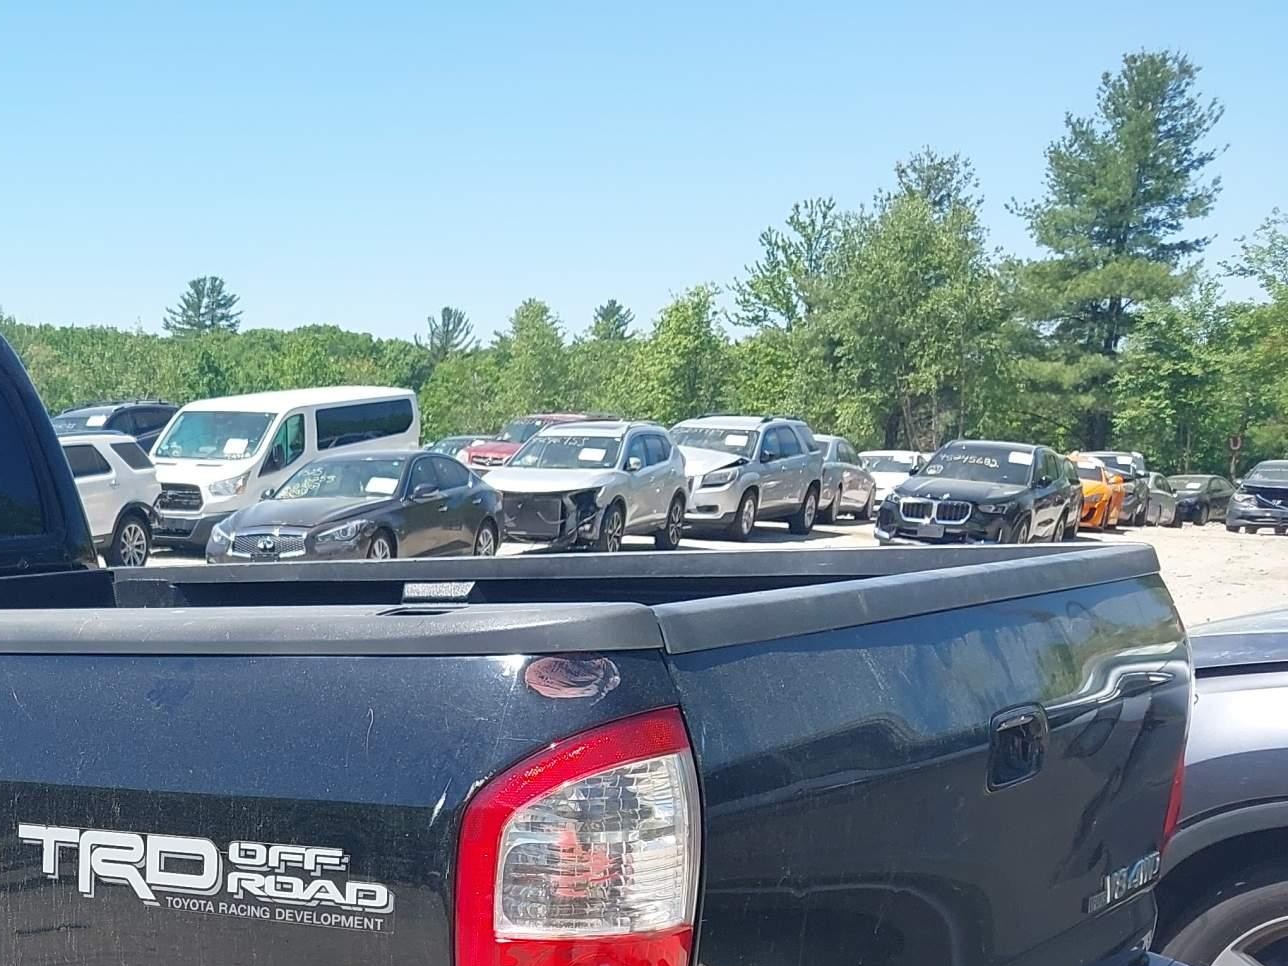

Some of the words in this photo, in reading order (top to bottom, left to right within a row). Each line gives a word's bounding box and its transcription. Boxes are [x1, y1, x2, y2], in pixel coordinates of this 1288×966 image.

[18, 824, 223, 906] TRD
[228, 841, 349, 876] OFF
[227, 872, 394, 914] ROAD
[166, 896, 214, 914] TOYOTA
[218, 903, 270, 918] RACING
[275, 908, 384, 931] DEVELOPMENT
